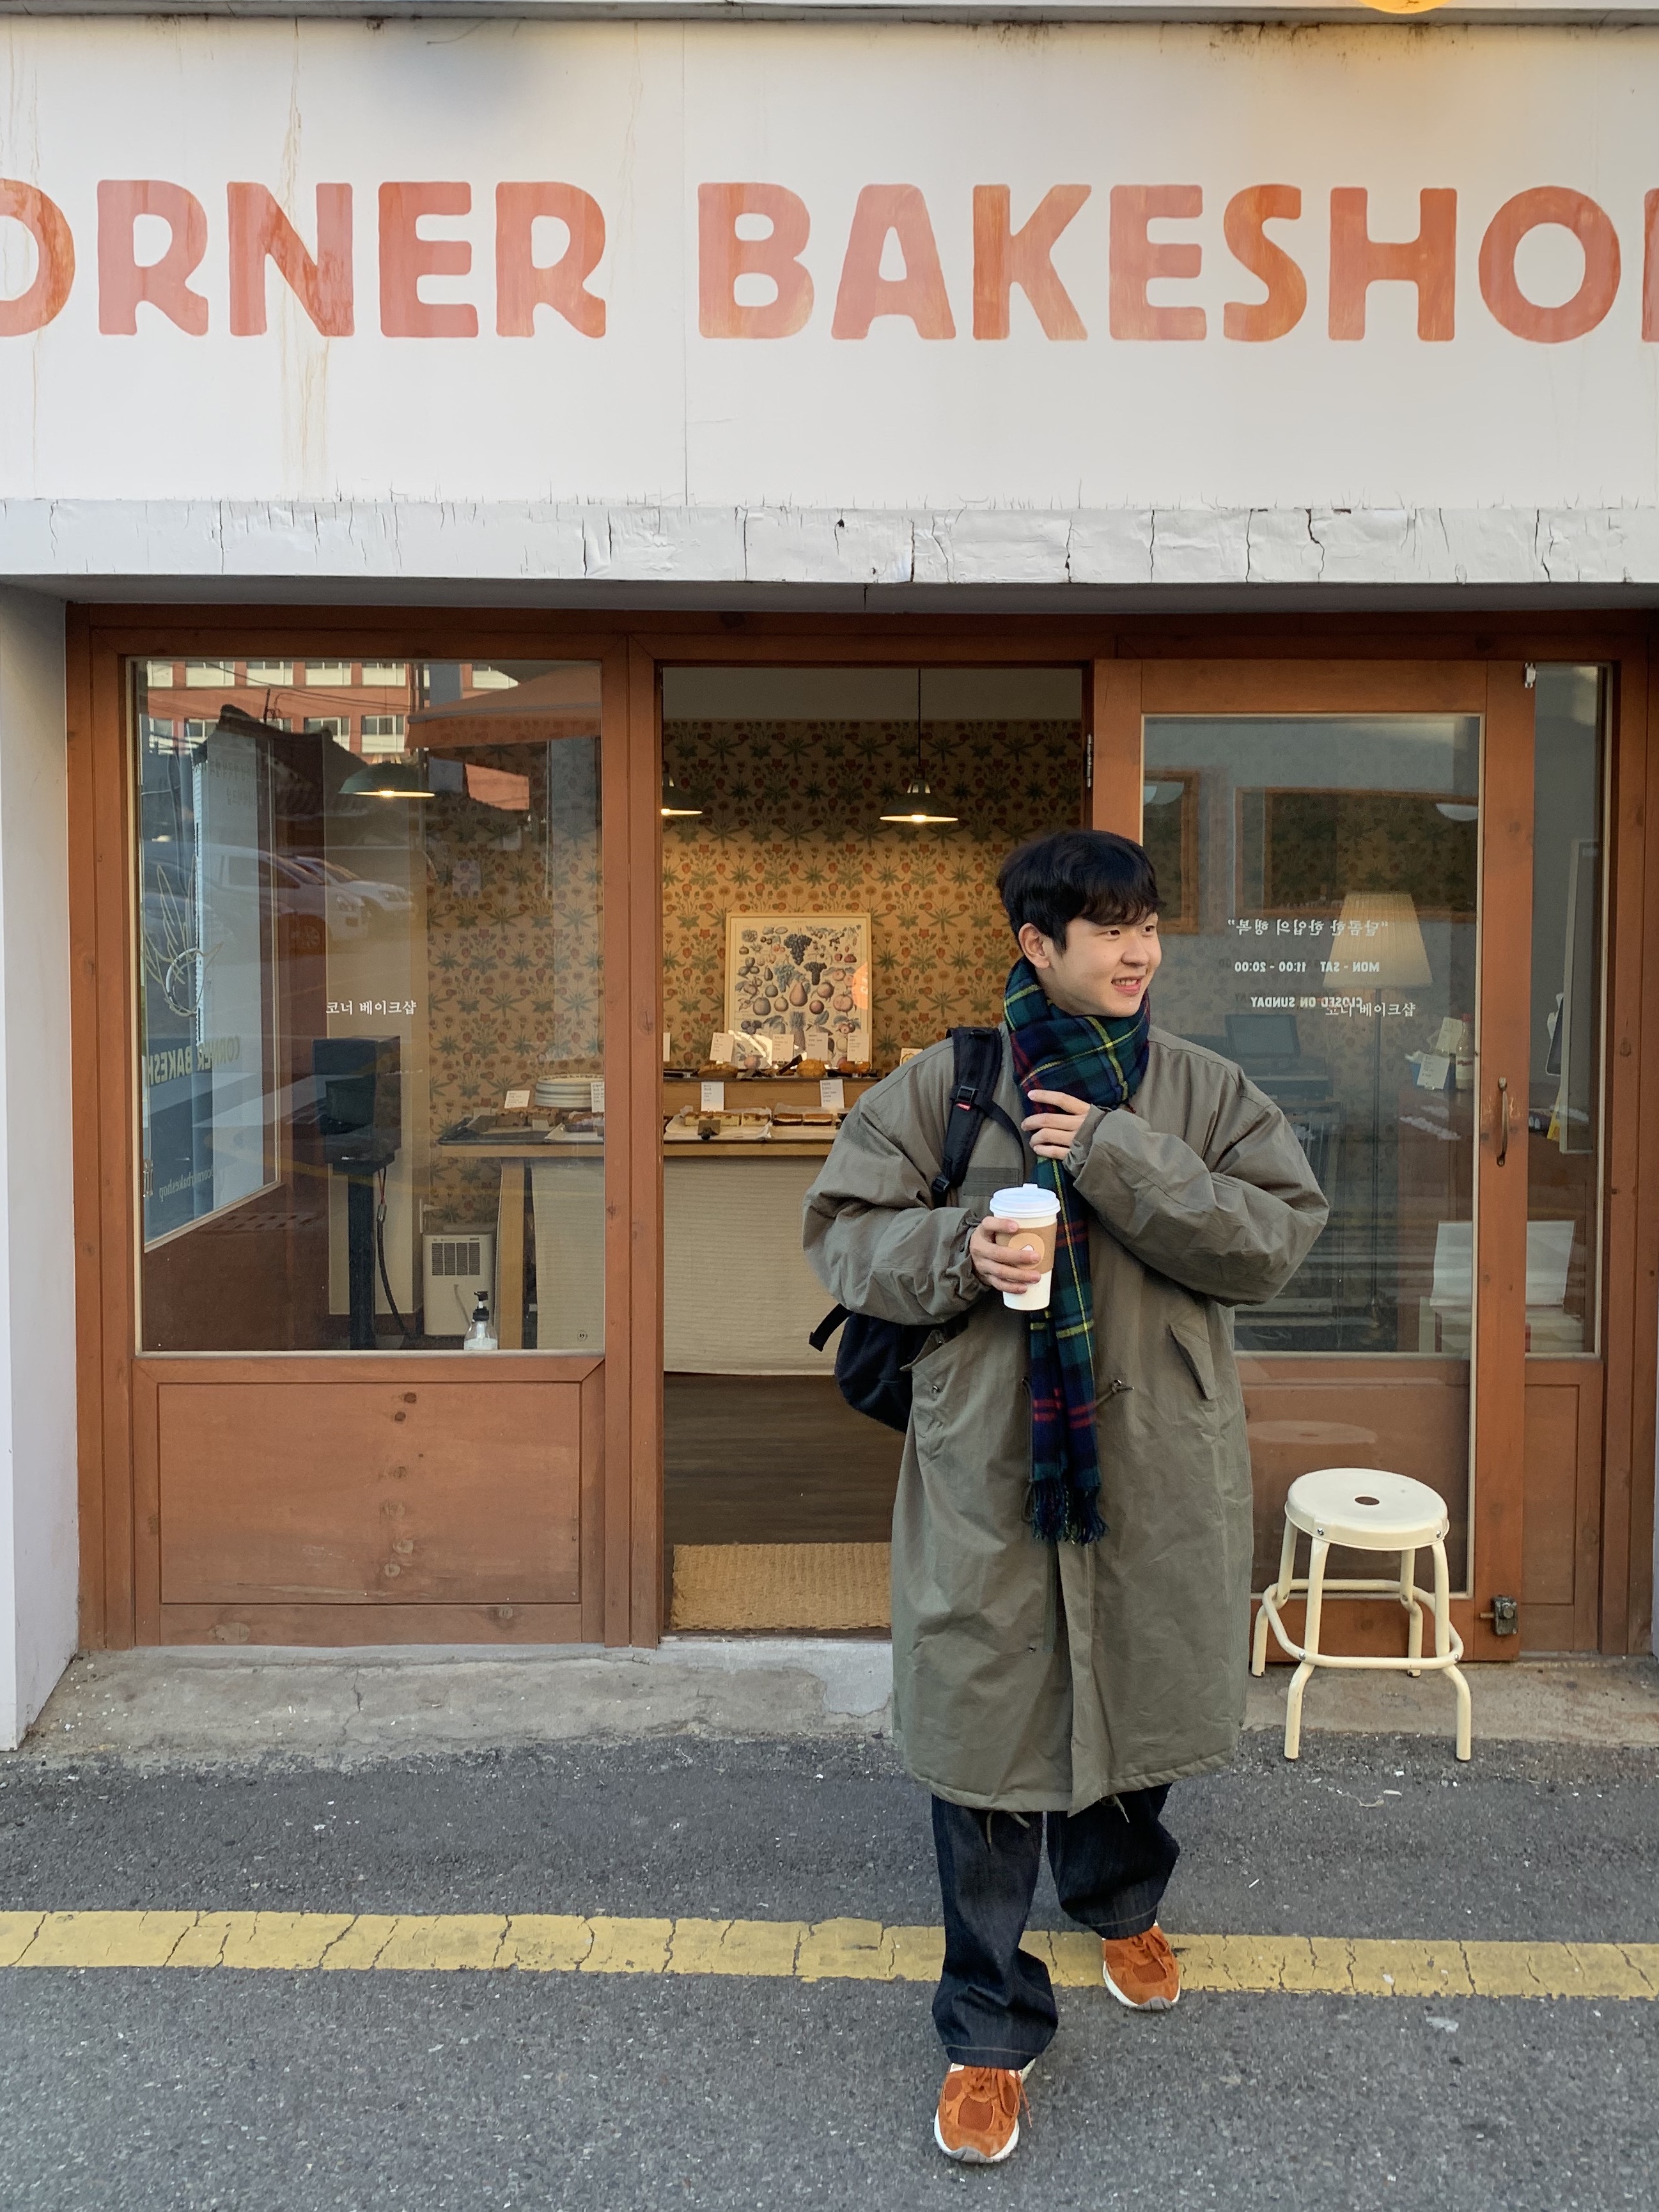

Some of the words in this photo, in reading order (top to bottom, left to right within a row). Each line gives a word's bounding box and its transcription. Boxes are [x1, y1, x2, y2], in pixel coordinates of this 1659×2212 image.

[697, 182, 1659, 344] BAKESHO
[326, 1000, 353, 1015] 코너
[359, 1000, 417, 1015] 베이크샵
[1359, 1002, 1416, 1017] 베이크샵
